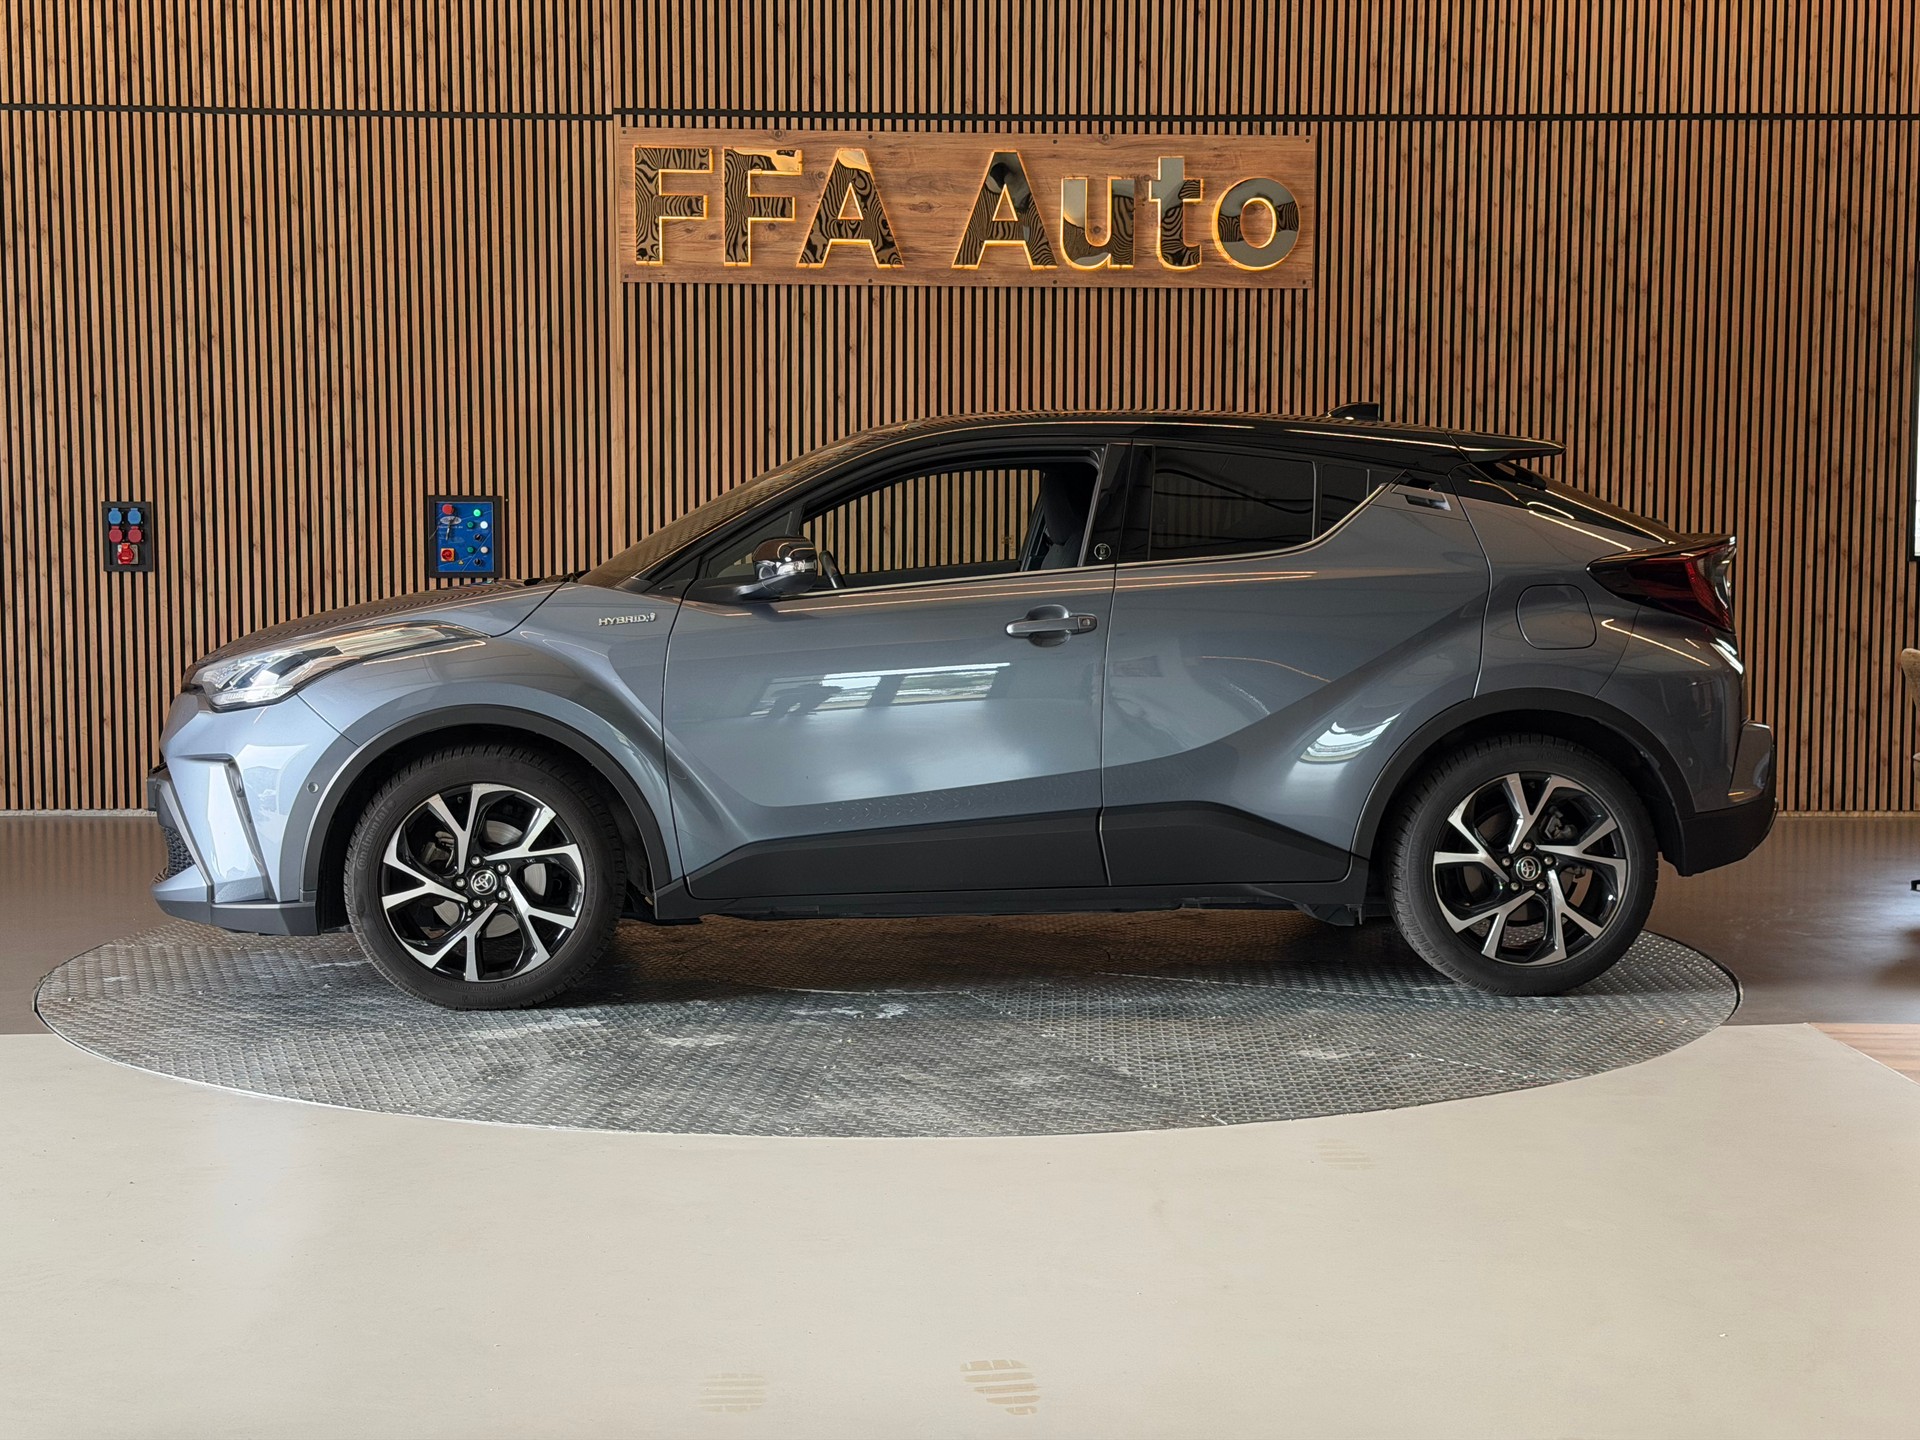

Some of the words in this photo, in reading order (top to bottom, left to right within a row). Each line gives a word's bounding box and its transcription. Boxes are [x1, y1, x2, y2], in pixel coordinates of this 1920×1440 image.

[633, 146, 903, 269] FFA
[951, 149, 1300, 272] Auto
[598, 614, 646, 626] HYBRID
